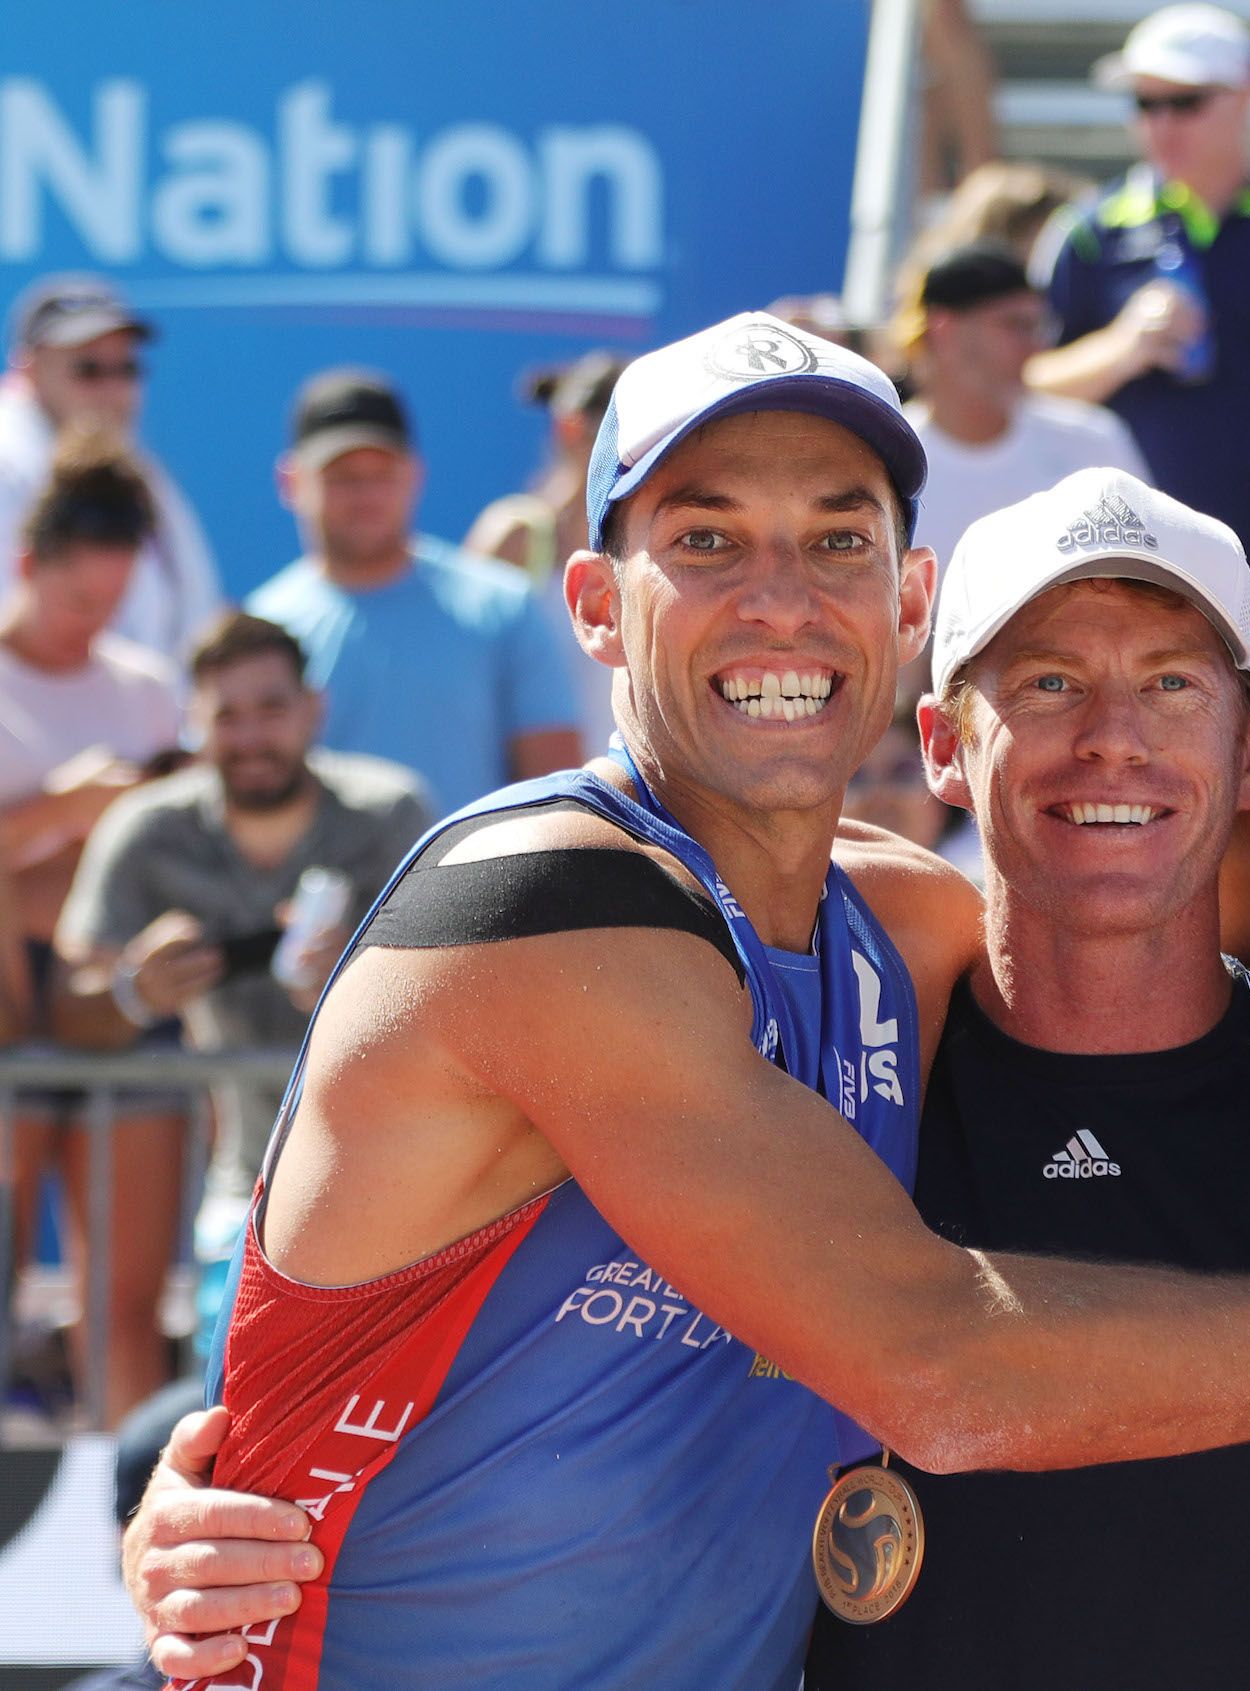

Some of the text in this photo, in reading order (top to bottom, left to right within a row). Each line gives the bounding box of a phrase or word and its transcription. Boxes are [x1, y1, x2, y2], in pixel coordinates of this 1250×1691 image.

[0, 77, 664, 271] Nation
[1056, 525, 1159, 552] adidas
[843, 1059, 856, 1120] FIVB
[1043, 1157, 1121, 1179] adidas
[555, 1287, 688, 1340] FORT
[852, 1601, 881, 1616] PLACE
